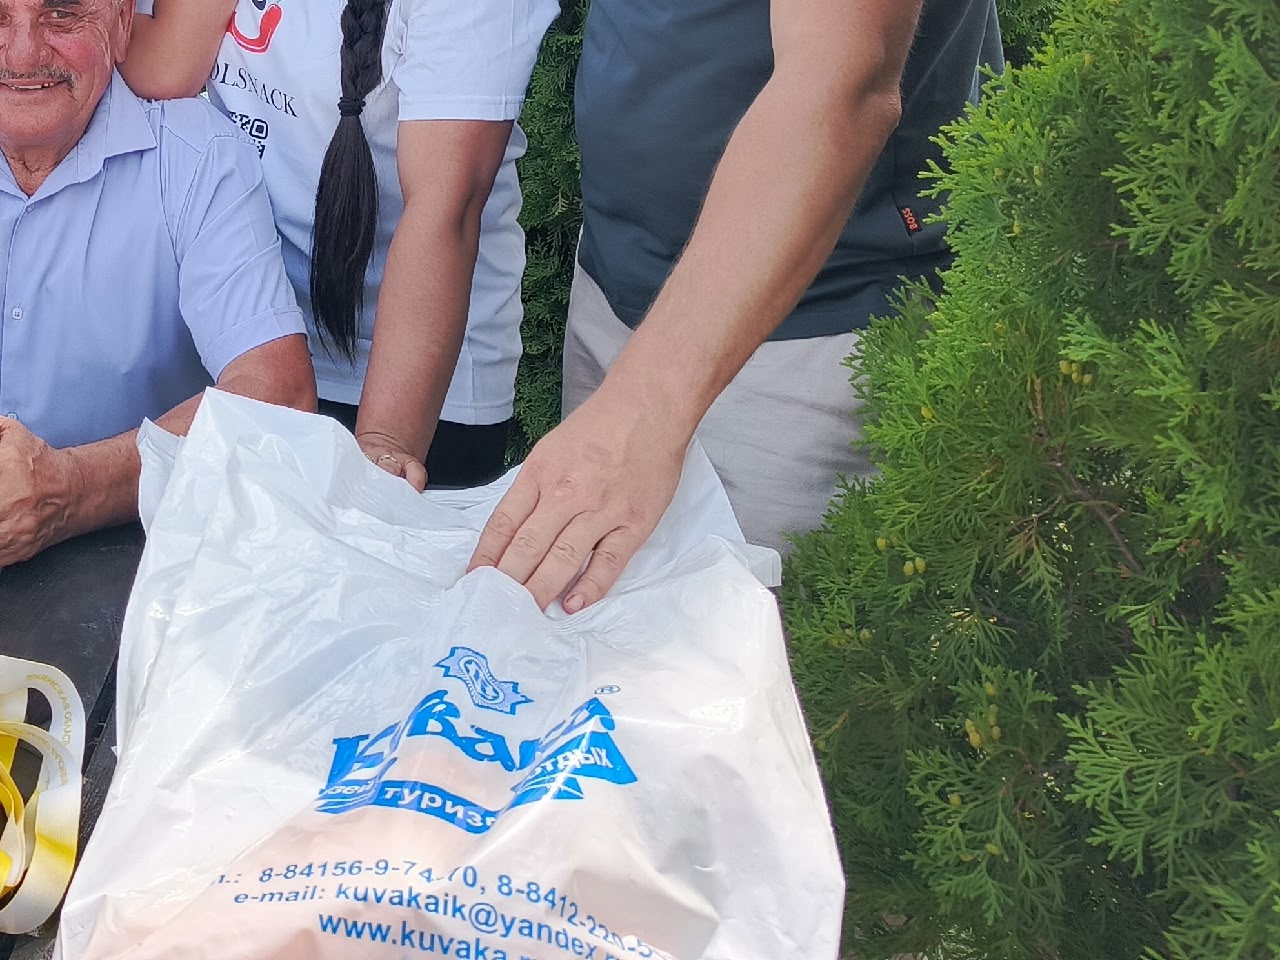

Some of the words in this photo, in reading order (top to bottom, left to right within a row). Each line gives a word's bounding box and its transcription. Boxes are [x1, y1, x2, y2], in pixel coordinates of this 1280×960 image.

[209, 60, 300, 118] OLSNACK
[900, 207, 918, 230] BOSS
[234, 885, 326, 904] e-mail:
